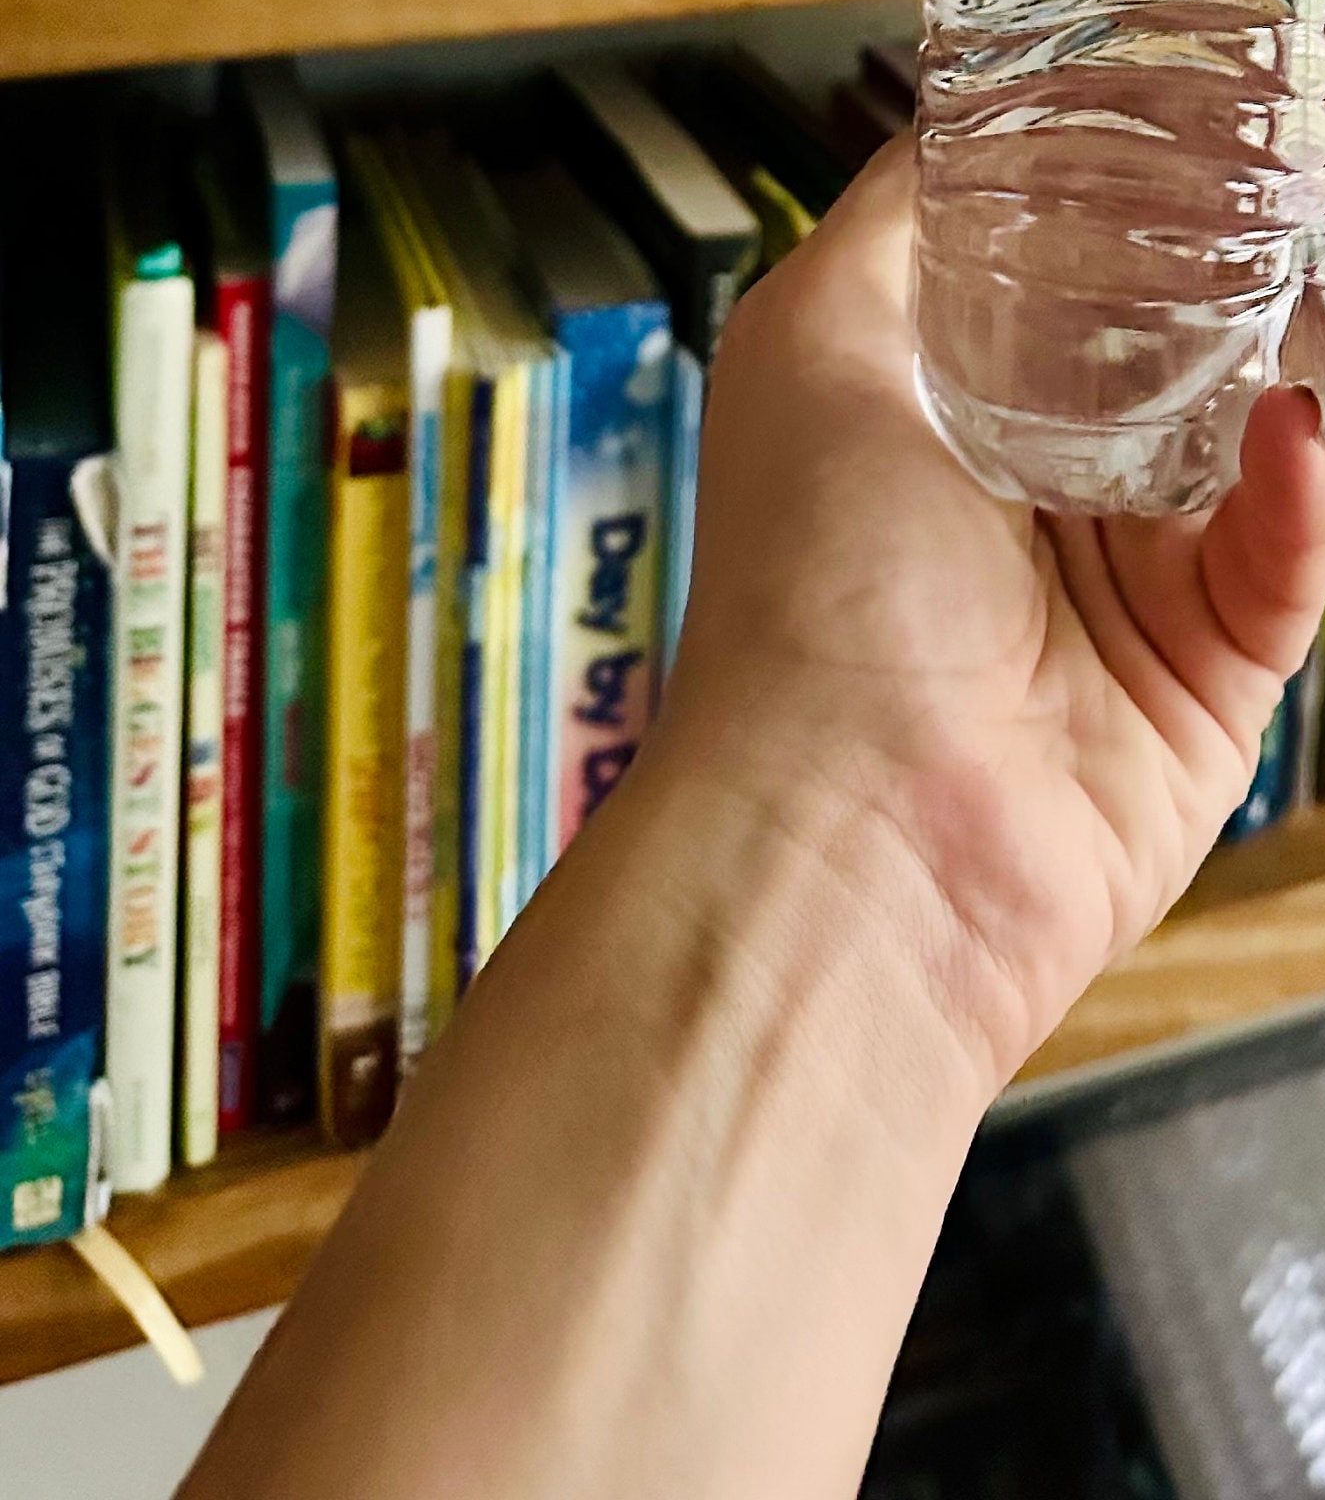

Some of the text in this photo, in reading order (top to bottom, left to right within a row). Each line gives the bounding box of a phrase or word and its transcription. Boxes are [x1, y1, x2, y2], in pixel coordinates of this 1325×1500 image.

[574, 511, 647, 636] Day
[572, 647, 646, 726] by
[121, 828, 160, 968] STORY
